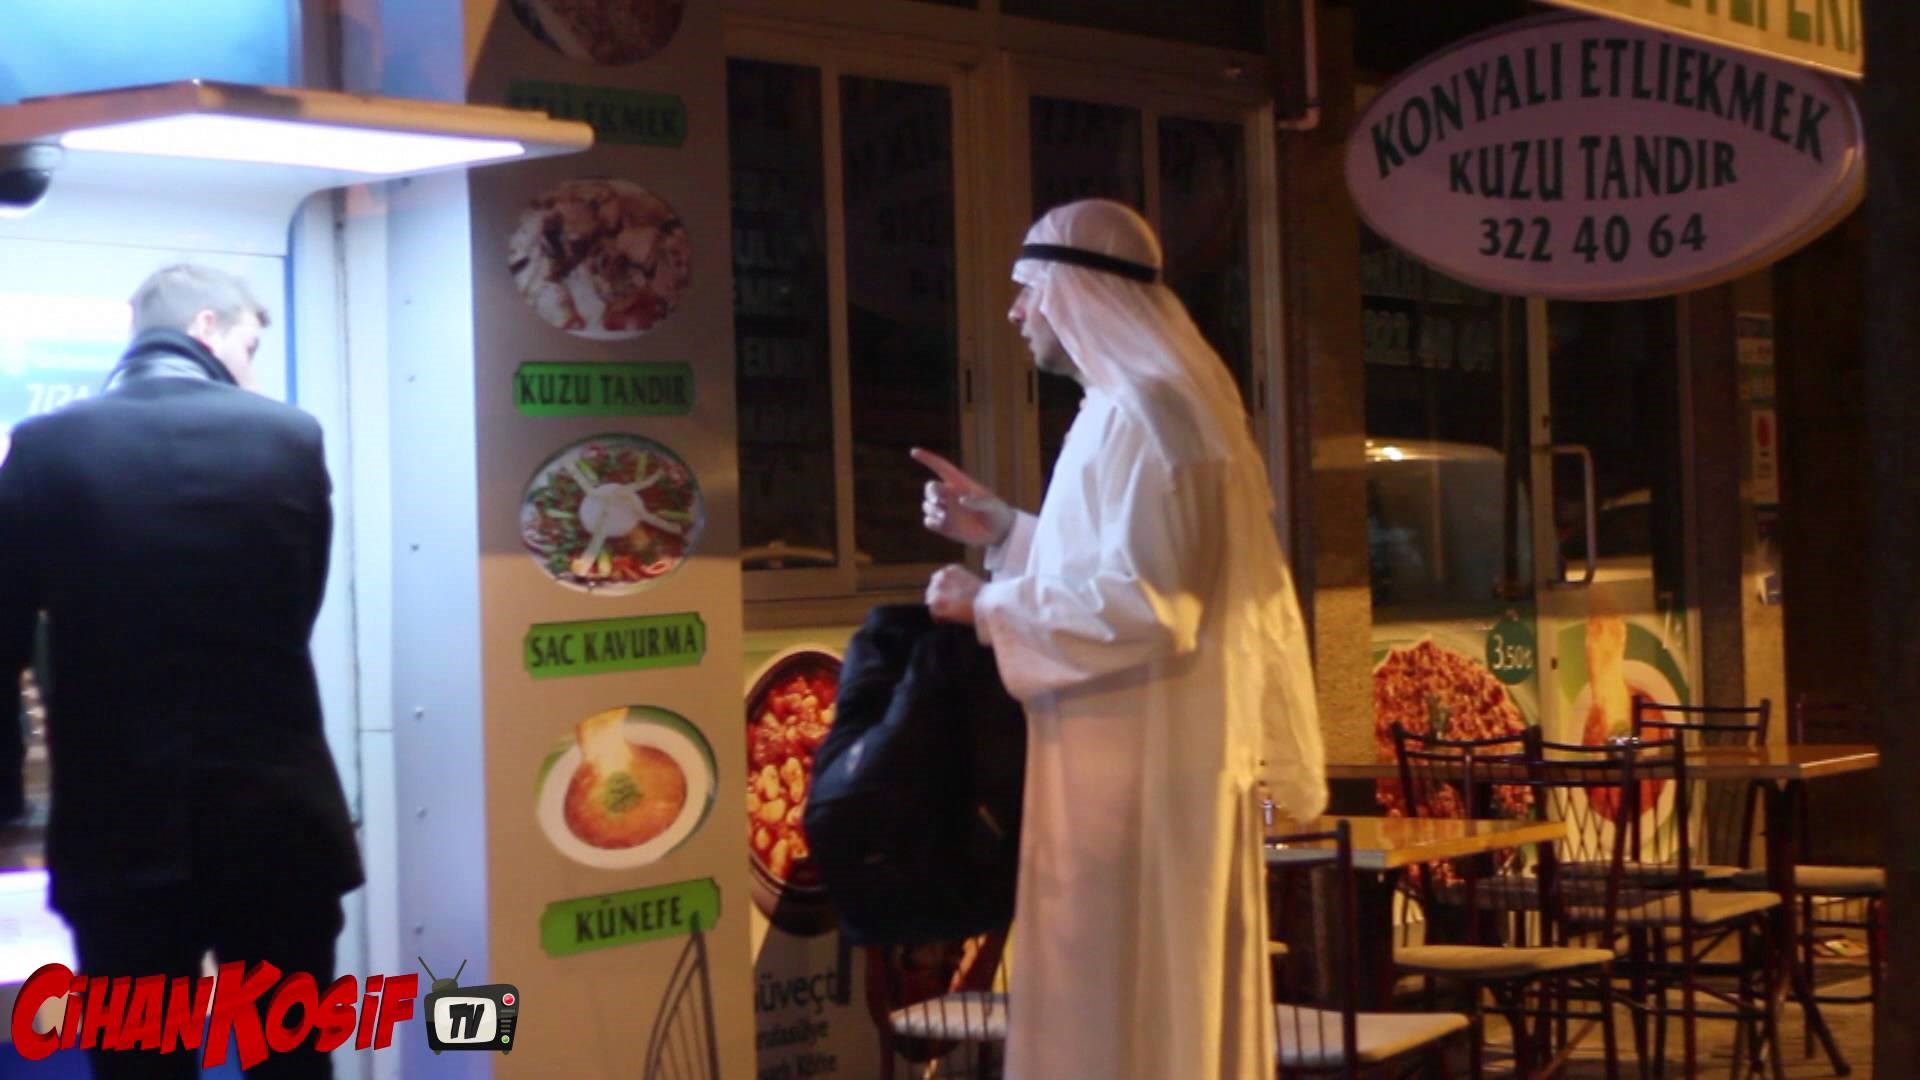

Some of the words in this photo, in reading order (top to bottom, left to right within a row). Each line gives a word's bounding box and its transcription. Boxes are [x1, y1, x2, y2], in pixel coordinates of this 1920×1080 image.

[1371, 42, 1563, 180] KONYALI
[1449, 136, 1564, 200] KUZU
[1579, 135, 1738, 201] TANDIR
[1479, 216, 1552, 262] 322
[1573, 214, 1631, 263] 40
[1648, 213, 1707, 258] 64
[519, 374, 591, 405] KUZU
[599, 374, 688, 405] TANDIR
[530, 635, 574, 667] SAC
[583, 624, 697, 664] KAVURMA
[576, 895, 683, 943] KÜNEFE
